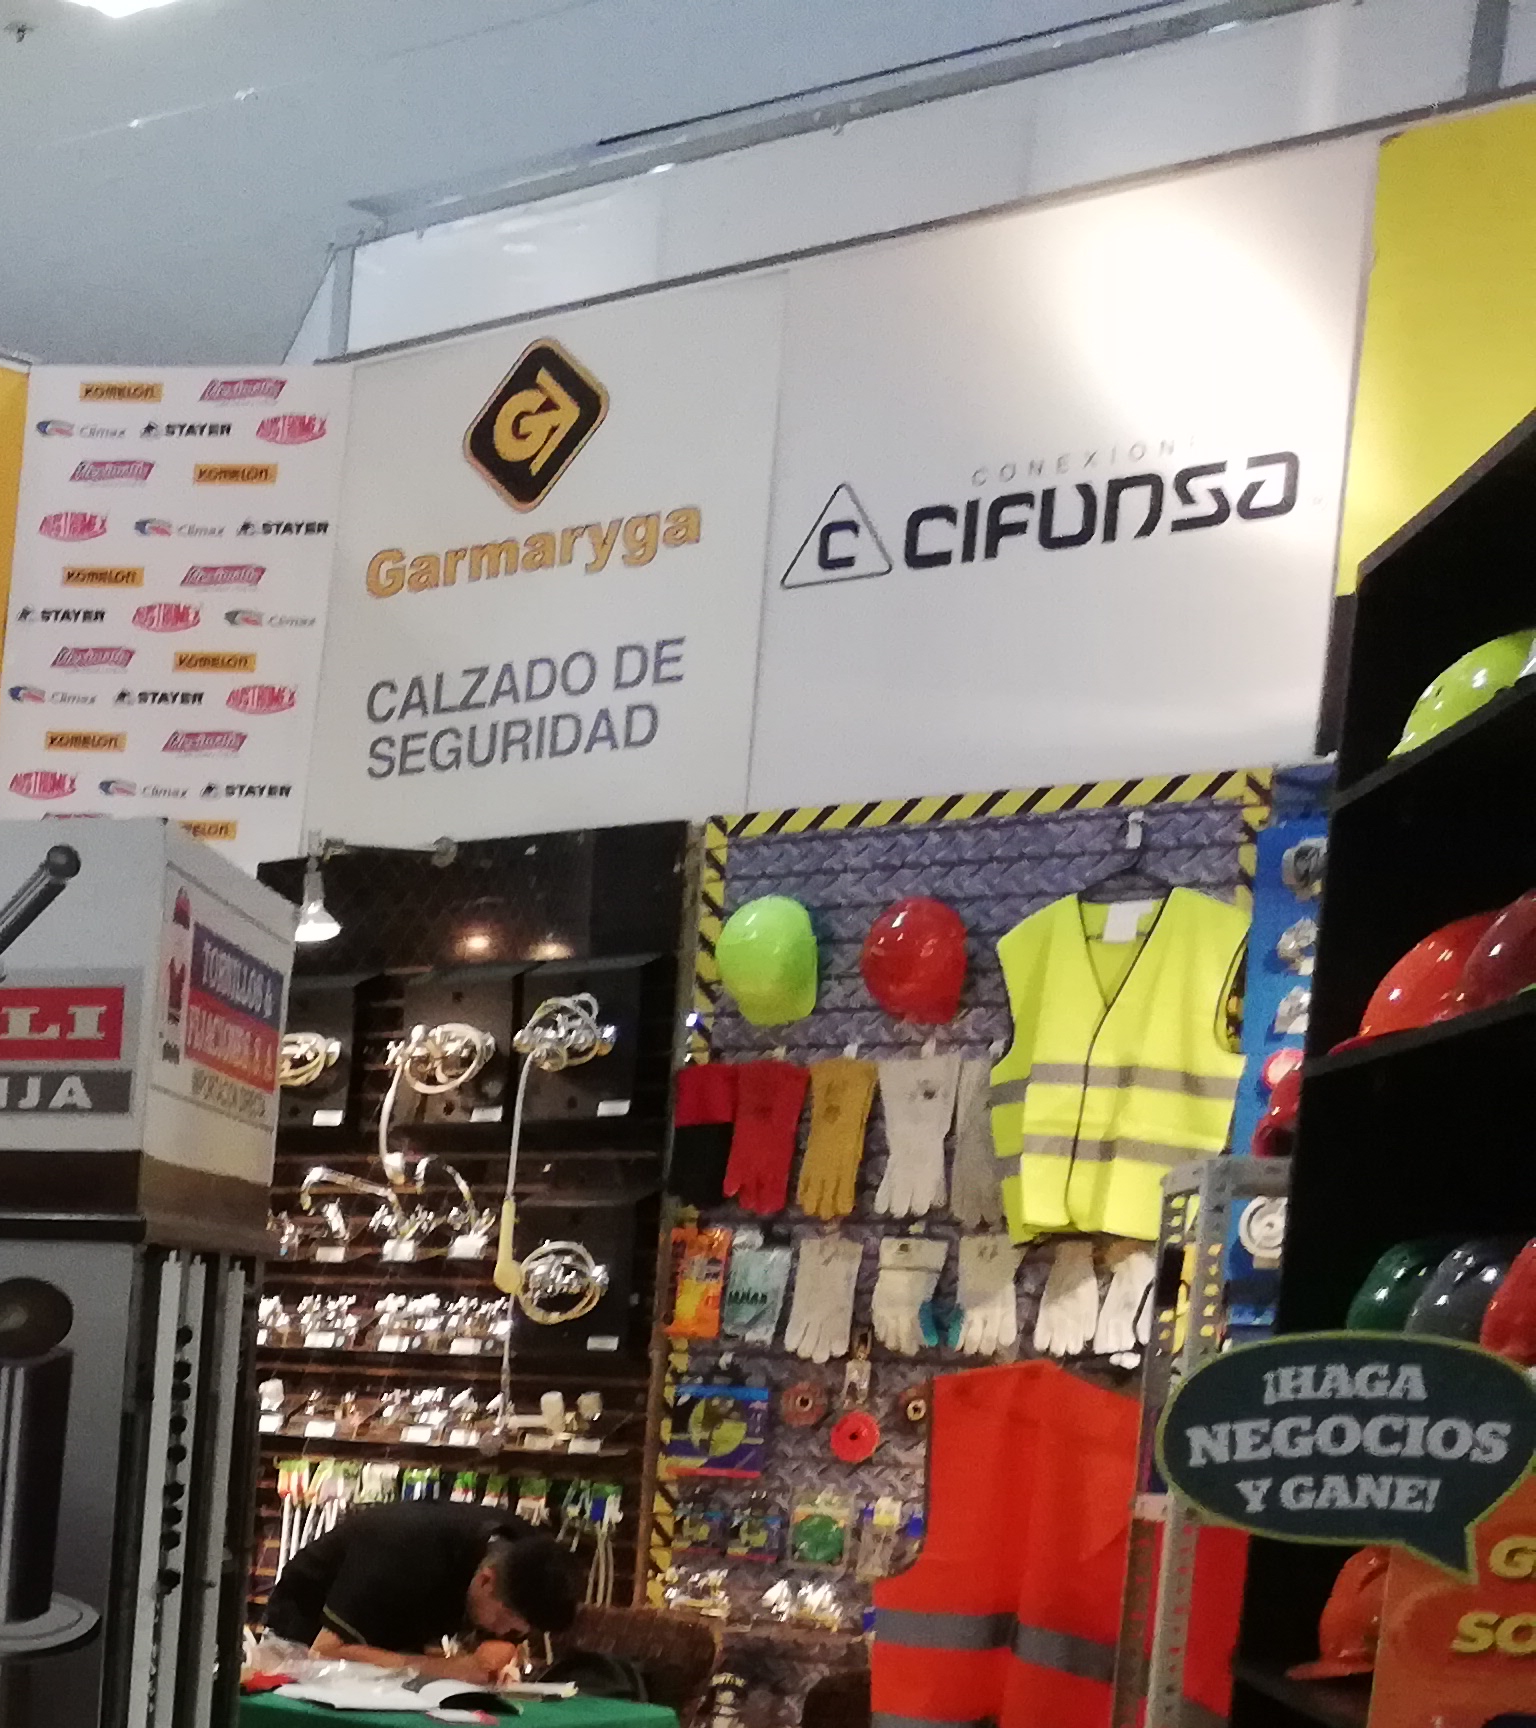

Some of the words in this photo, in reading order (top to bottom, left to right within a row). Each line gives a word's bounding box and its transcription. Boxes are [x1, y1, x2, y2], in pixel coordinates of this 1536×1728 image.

[366, 502, 702, 600] Garmaryga
[367, 647, 596, 726] CALZADO
[611, 636, 686, 689] DE
[367, 703, 659, 782] SEGURIDAD
[1262, 1363, 1428, 1405] ¡HAGA
[1185, 1413, 1512, 1468] NEGOCIOS
[1234, 1478, 1273, 1514] Y
[1279, 1473, 1442, 1512] GANE!
